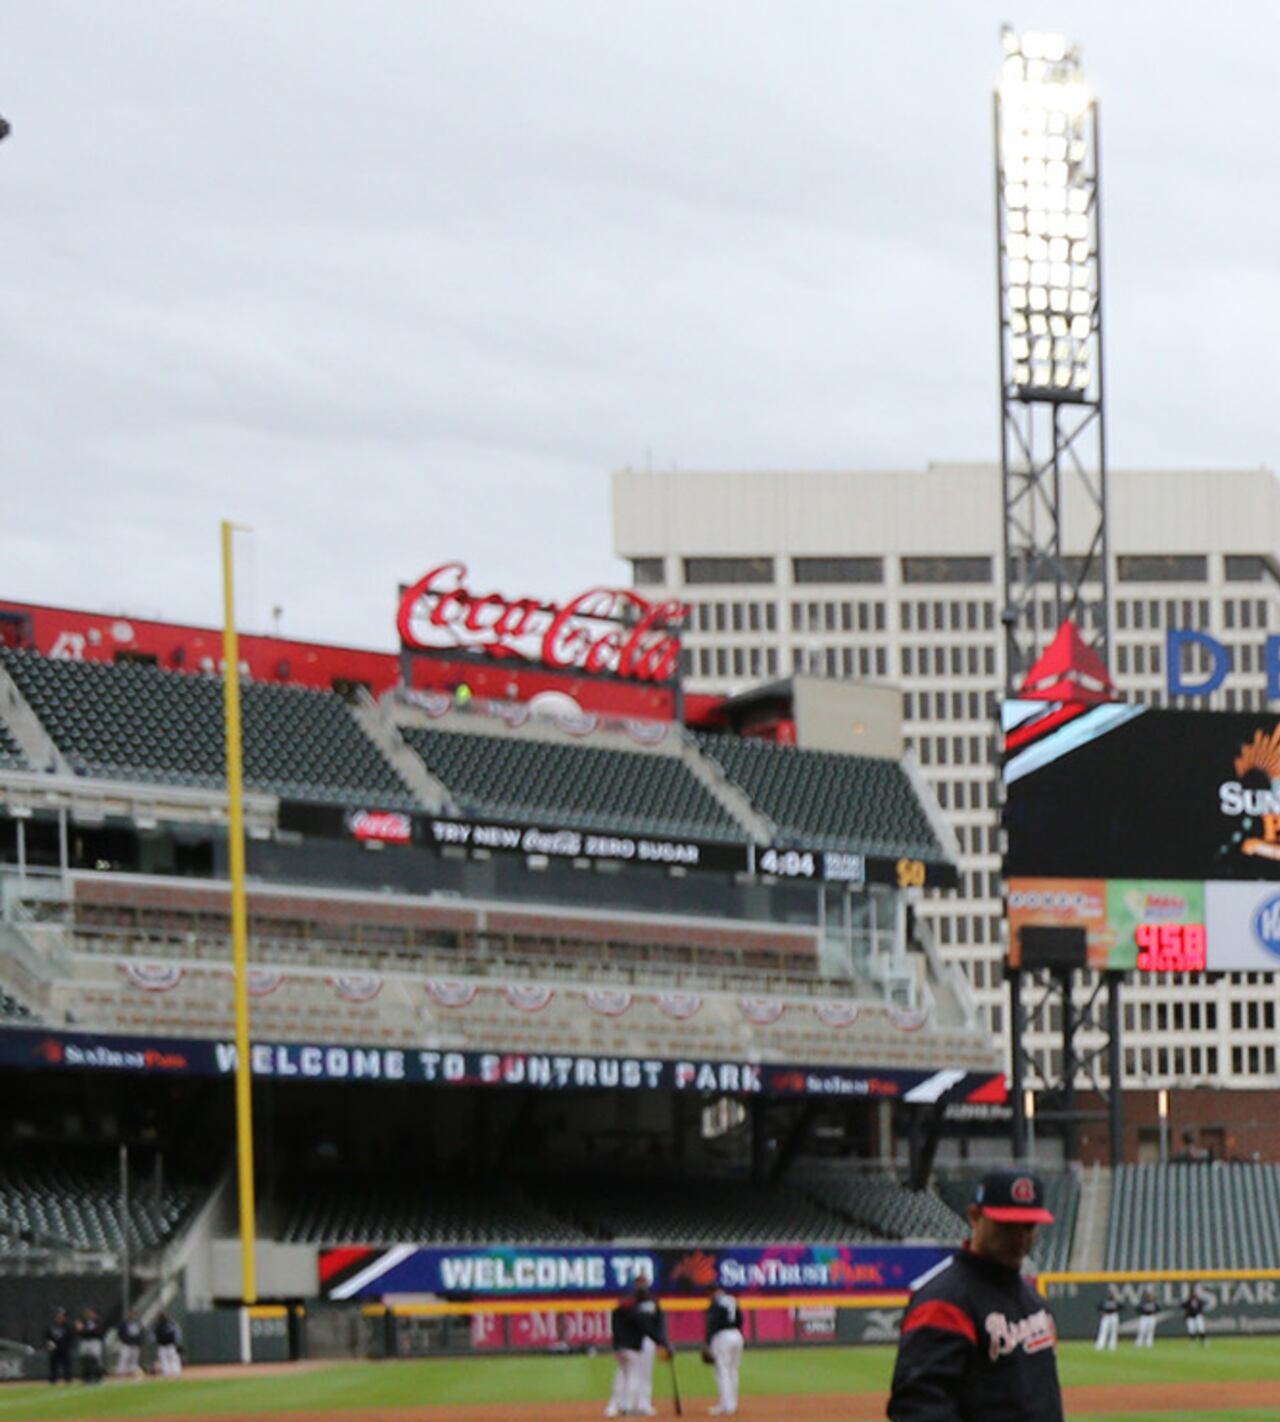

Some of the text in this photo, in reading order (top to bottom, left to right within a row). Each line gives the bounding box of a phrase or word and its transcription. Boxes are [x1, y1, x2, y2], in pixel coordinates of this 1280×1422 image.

[397, 562, 692, 683] Coca-Cola
[214, 1043, 762, 1092] WELCOME TO SUNTRUST PARK
[440, 1256, 606, 1289] WELCOME
[612, 1257, 654, 1289] TO
